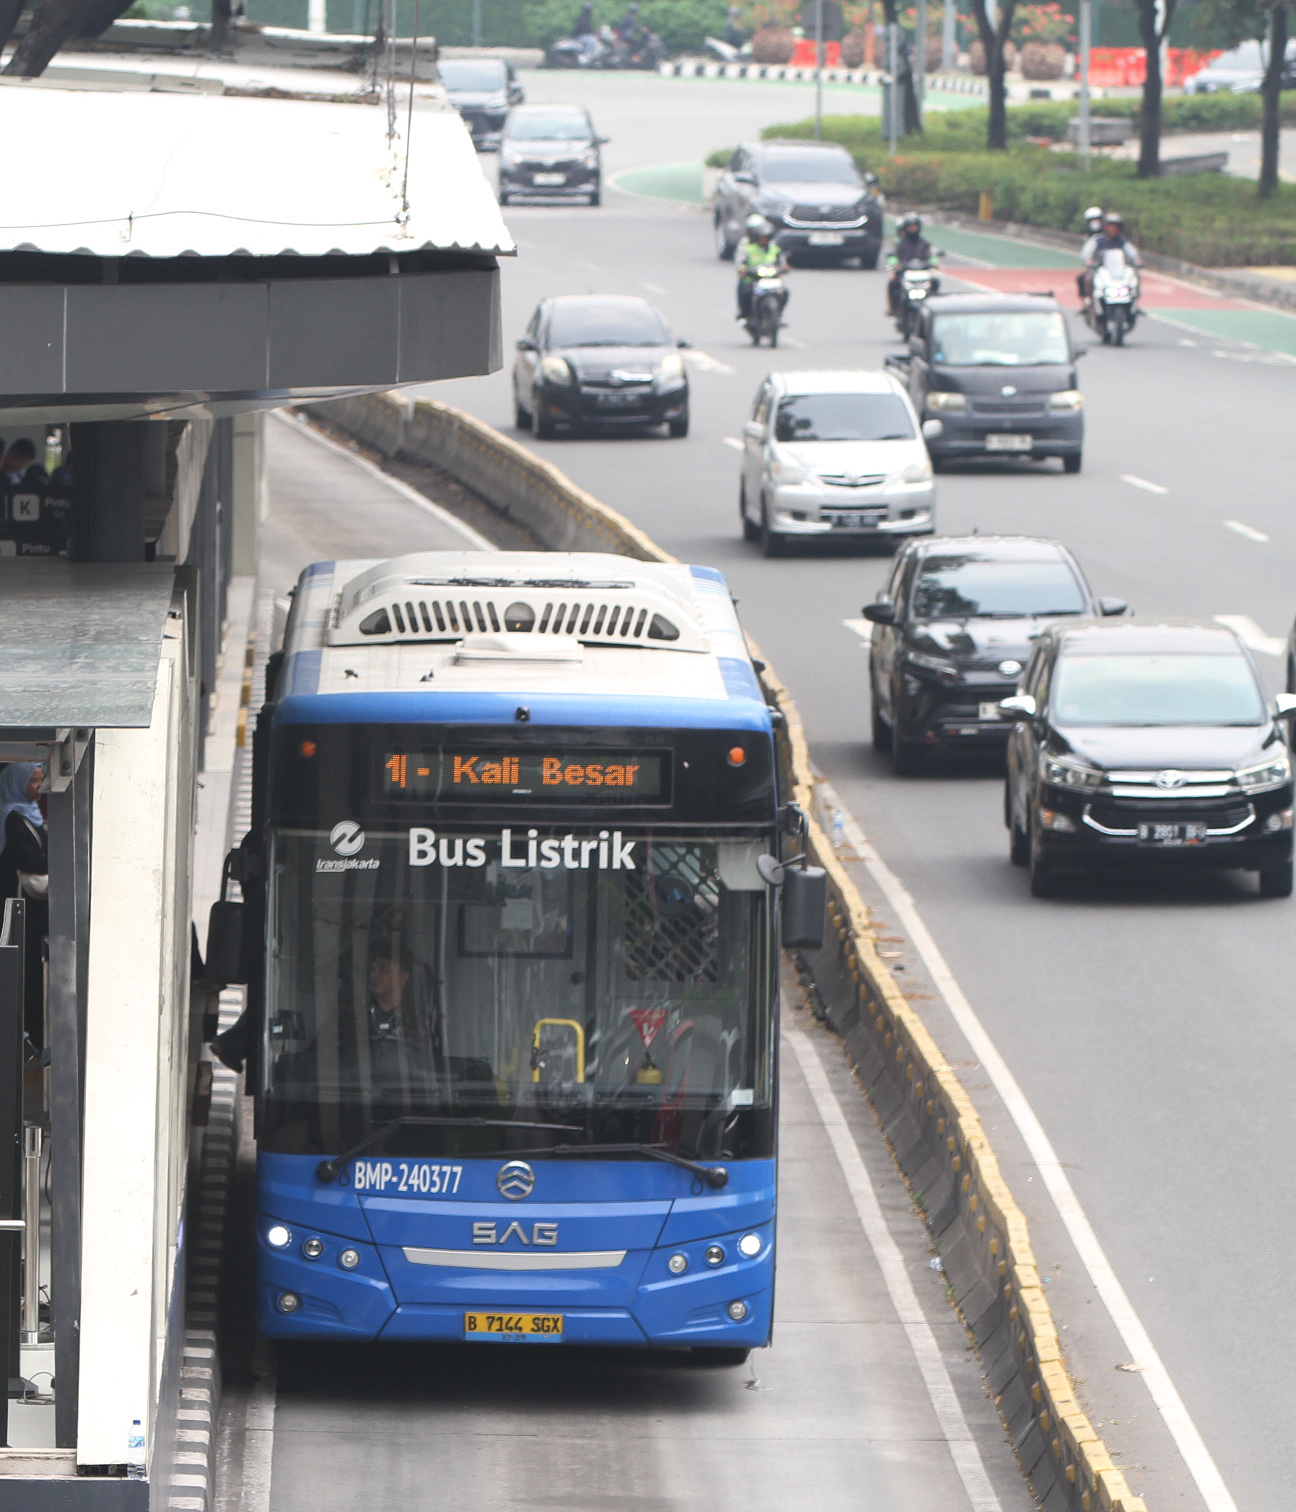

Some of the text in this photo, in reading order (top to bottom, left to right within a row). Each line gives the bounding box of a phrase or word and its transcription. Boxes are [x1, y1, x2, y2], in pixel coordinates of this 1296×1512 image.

[19, 500, 32, 516] K
[453, 755, 519, 784] Kali
[542, 757, 640, 786] Besar
[408, 827, 637, 870] Bus Listrik
[315, 857, 381, 873] transjakarta
[354, 1161, 463, 1194] BMP-240377
[472, 1221, 559, 1246] SAG
[467, 1315, 561, 1334] B 7144 SGX
